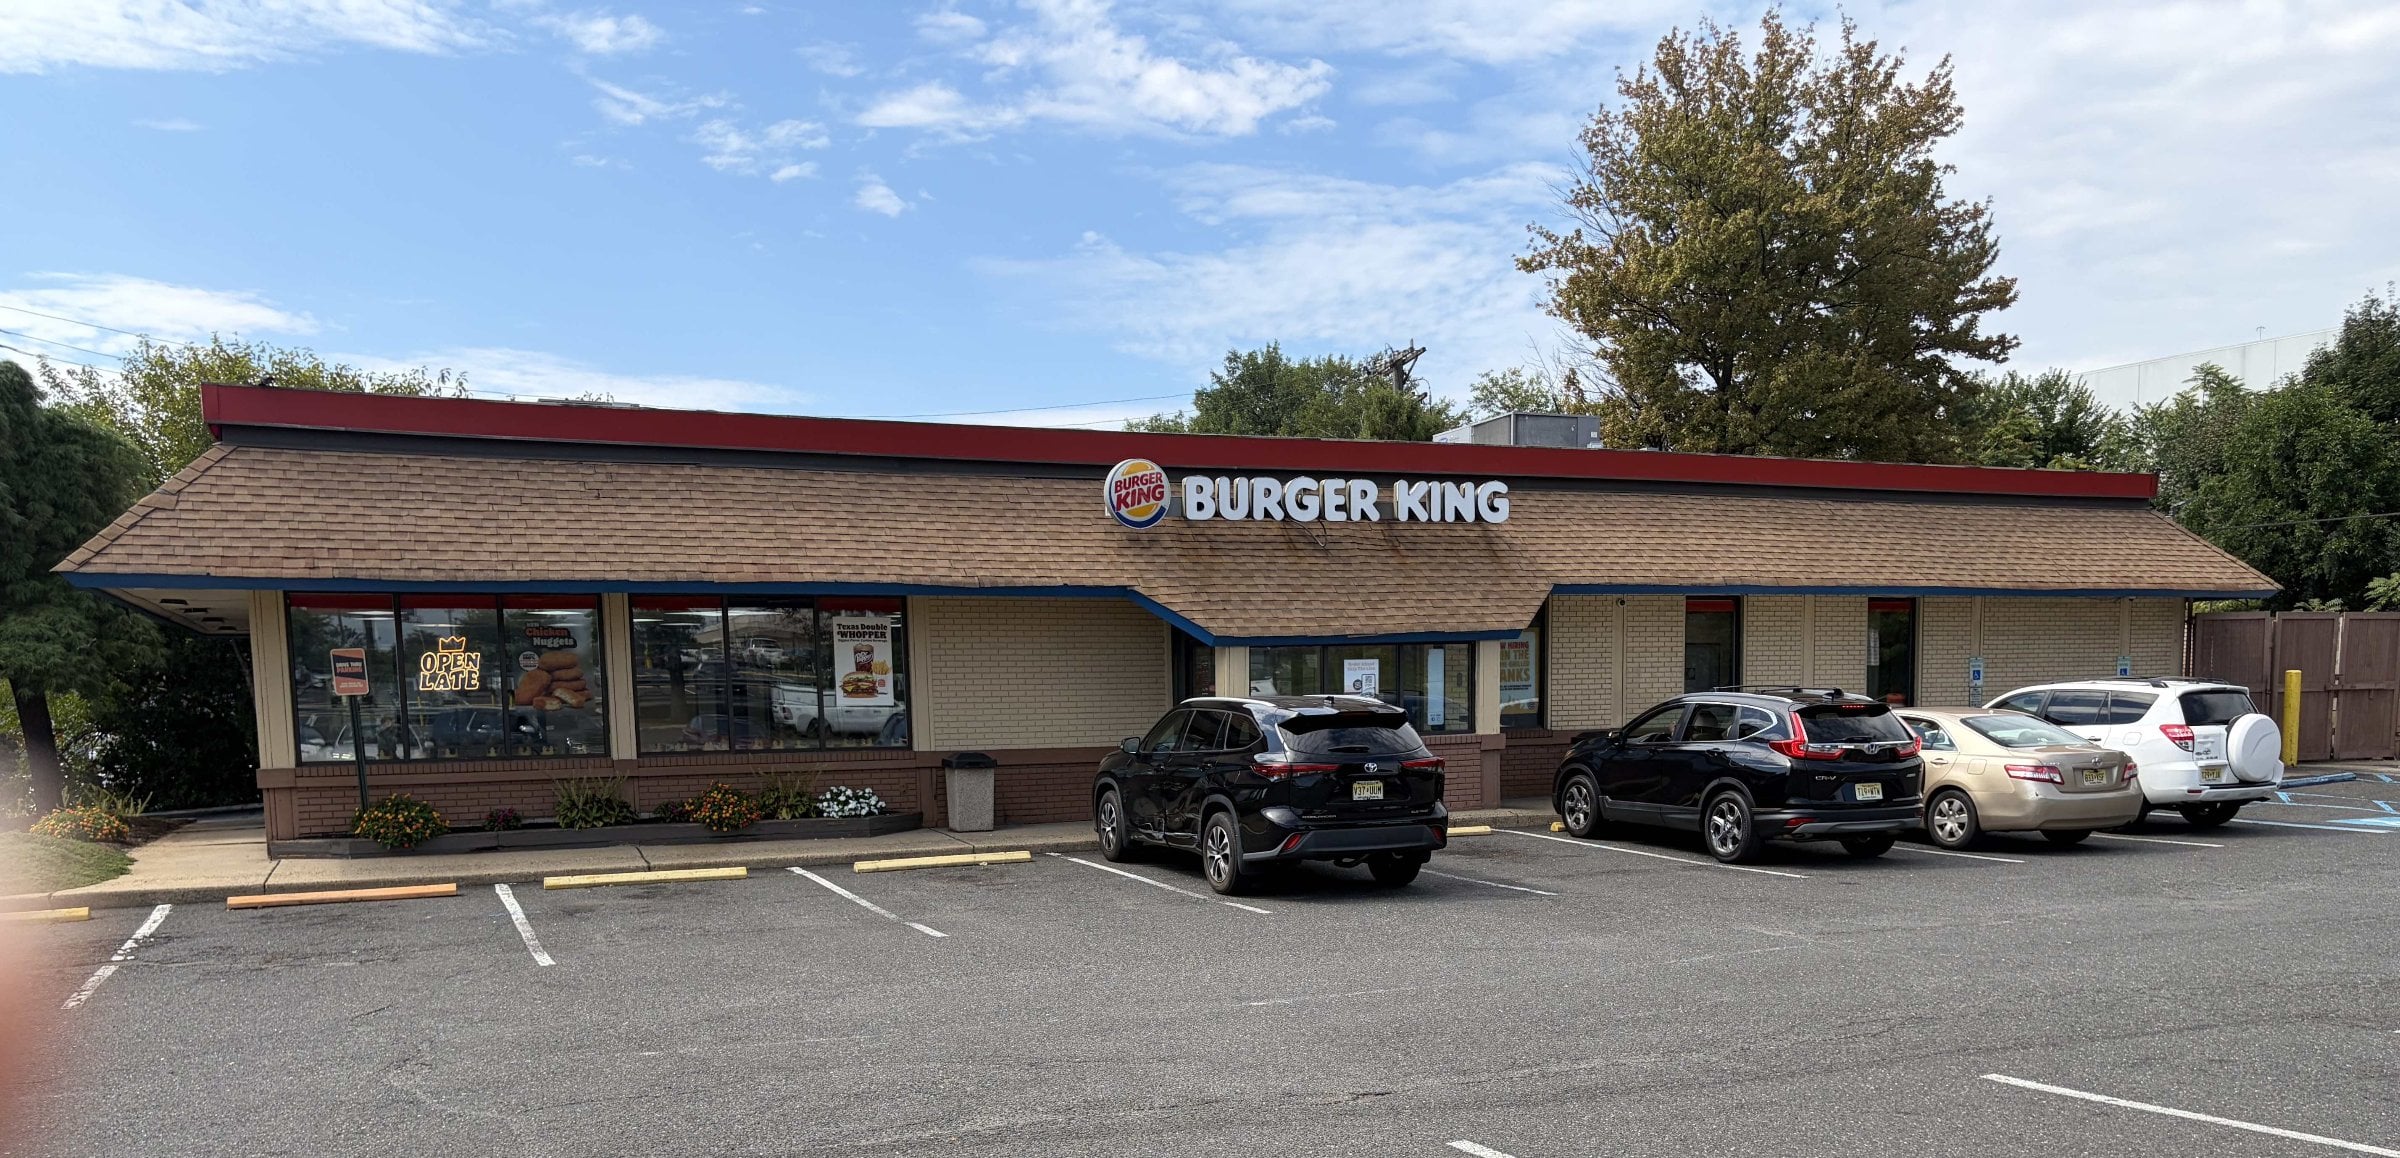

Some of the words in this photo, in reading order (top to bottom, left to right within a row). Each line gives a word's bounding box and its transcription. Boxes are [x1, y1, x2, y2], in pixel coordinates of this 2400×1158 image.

[1114, 471, 1163, 494] BURGER
[1116, 484, 1165, 512] KING
[1182, 475, 1381, 523] BURGER
[1394, 478, 1510, 524] KING
[525, 627, 568, 637] Chicken
[836, 623, 860, 631] Texas
[860, 623, 888, 631] Double
[836, 630, 887, 639] WHOPPER
[533, 637, 575, 648] Nuggets
[1508, 641, 1530, 649] HIRING
[420, 651, 481, 674] OPEN
[419, 668, 480, 691] LATE
[1500, 669, 1530, 683] ANKS
